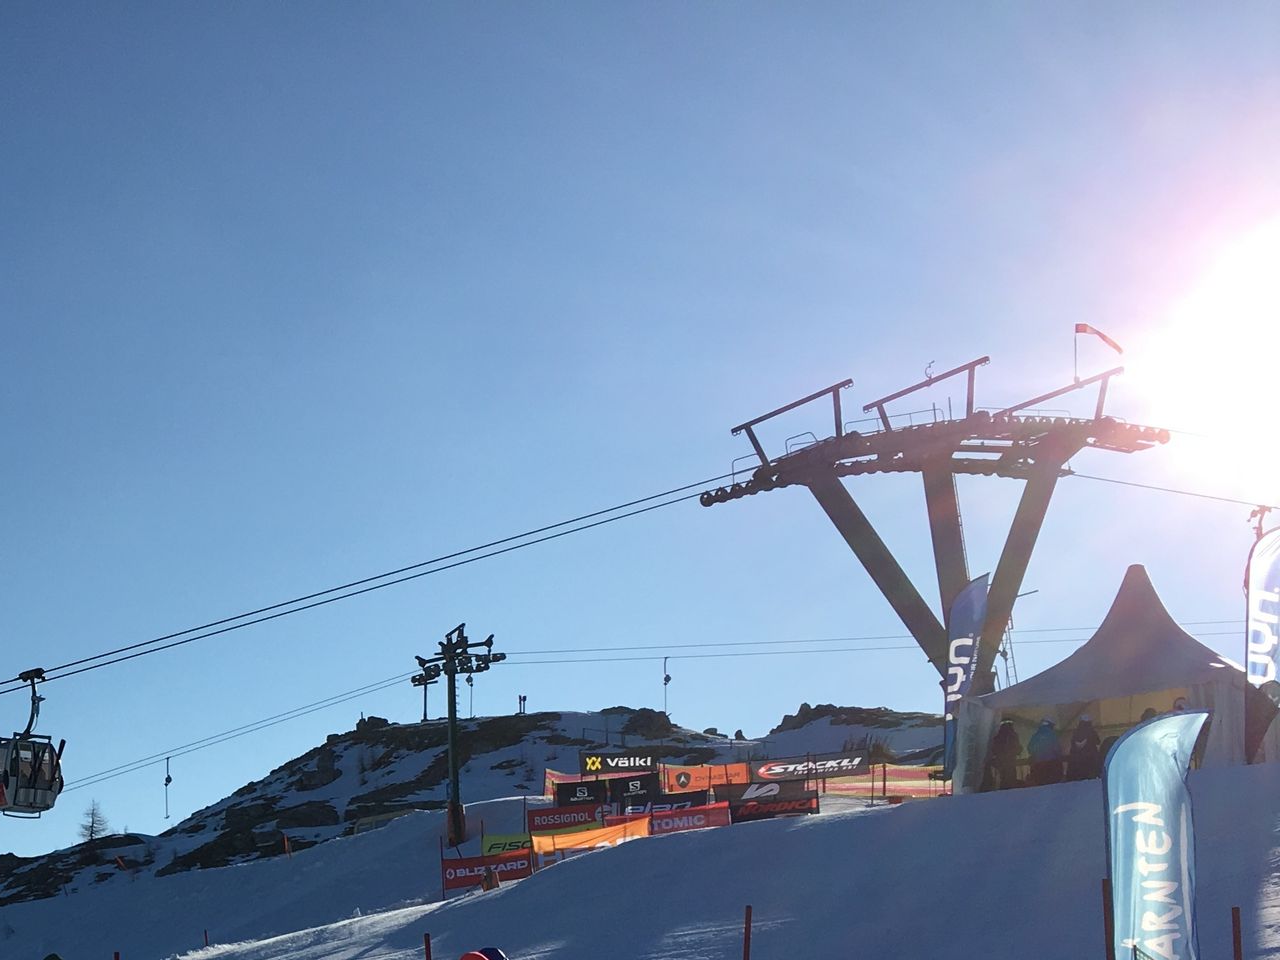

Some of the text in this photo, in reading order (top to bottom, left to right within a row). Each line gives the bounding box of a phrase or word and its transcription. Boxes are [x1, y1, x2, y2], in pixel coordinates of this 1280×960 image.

[606, 756, 652, 767] Völkl
[534, 811, 592, 826] ROSSIGNOL
[652, 814, 705, 831] TOMIC
[487, 839, 533, 853] FISC
[455, 860, 529, 878] BLIZZARD
